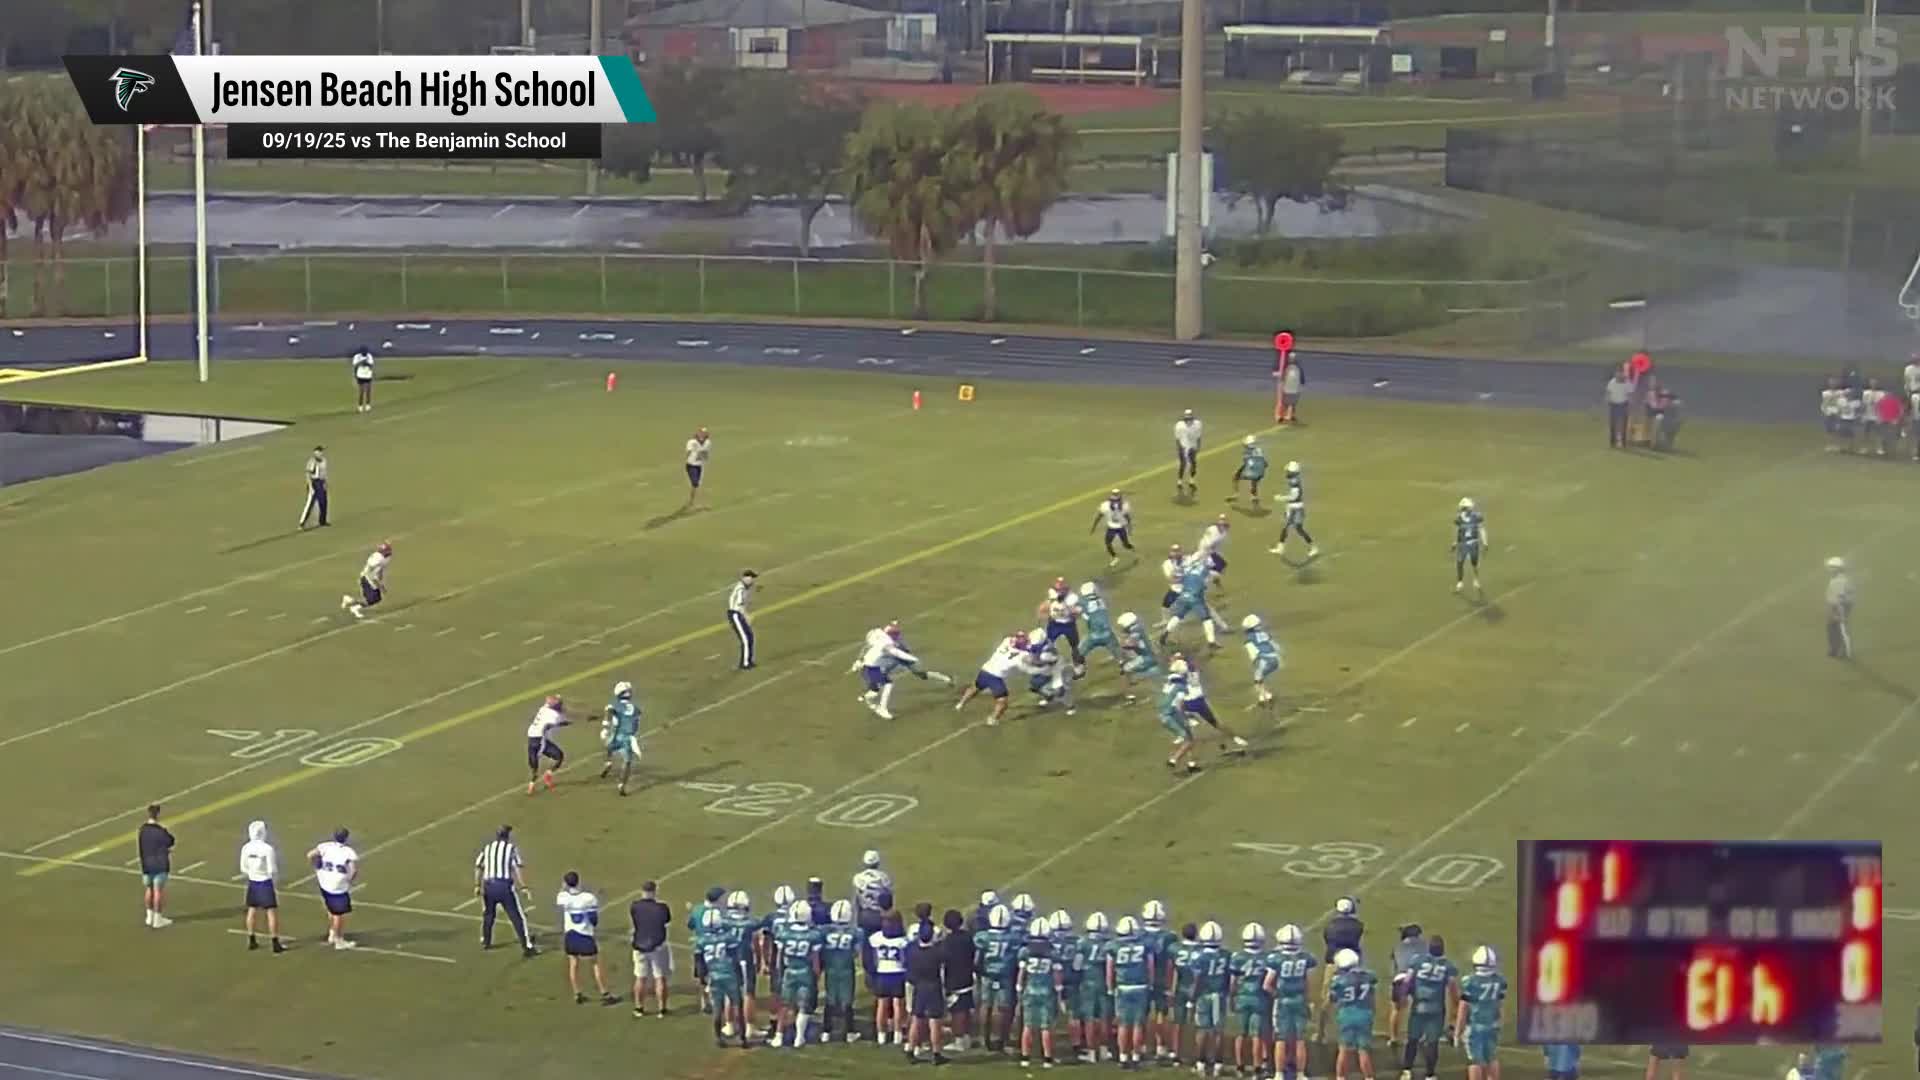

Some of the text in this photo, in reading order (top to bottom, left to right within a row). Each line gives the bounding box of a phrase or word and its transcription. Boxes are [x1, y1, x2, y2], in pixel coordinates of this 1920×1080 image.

[230, 729, 403, 767] 10
[704, 782, 919, 828] 20
[1284, 841, 1504, 892] 30
[784, 941, 809, 957] 29
[826, 934, 853, 950] 58
[1117, 945, 1145, 964] 62
[1207, 958, 1226, 975] 12
[1241, 959, 1264, 977] 42
[1281, 959, 1307, 978] 88
[1416, 962, 1446, 981] 25
[1343, 983, 1370, 1002] 37
[1478, 983, 1500, 1001] 71
